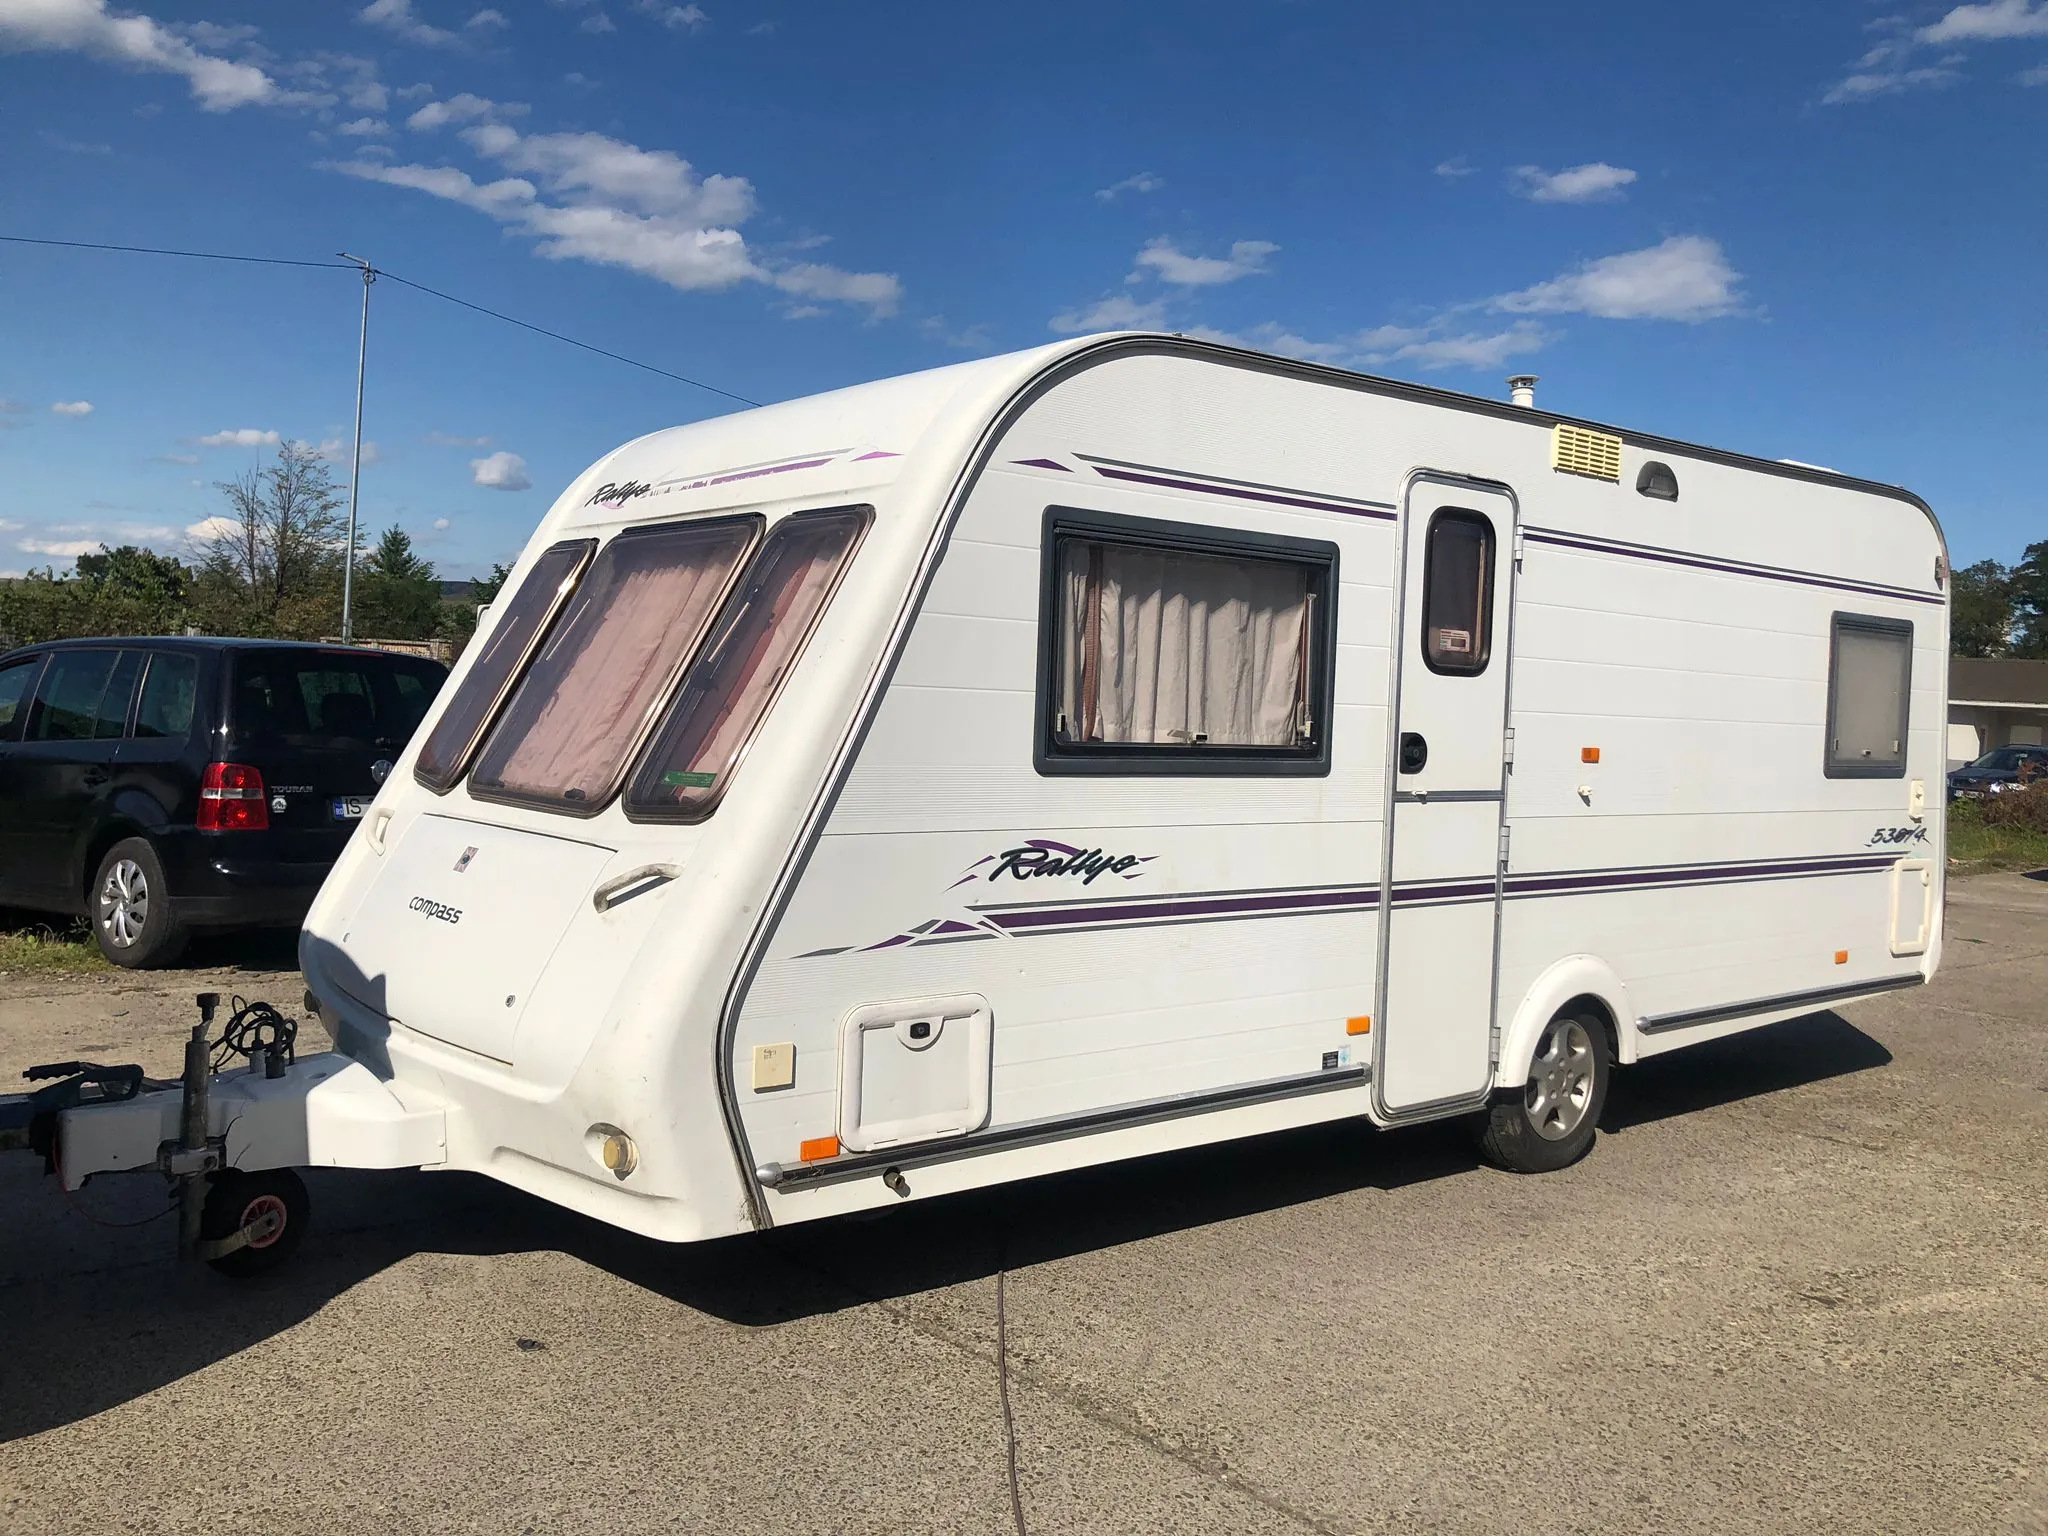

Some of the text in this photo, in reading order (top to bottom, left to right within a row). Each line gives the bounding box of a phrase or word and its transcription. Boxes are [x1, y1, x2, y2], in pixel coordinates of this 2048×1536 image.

[271, 785, 313, 793] TOURAN
[345, 798, 362, 815] IS
[988, 847, 1140, 886] Rallye
[409, 896, 463, 924] compass
